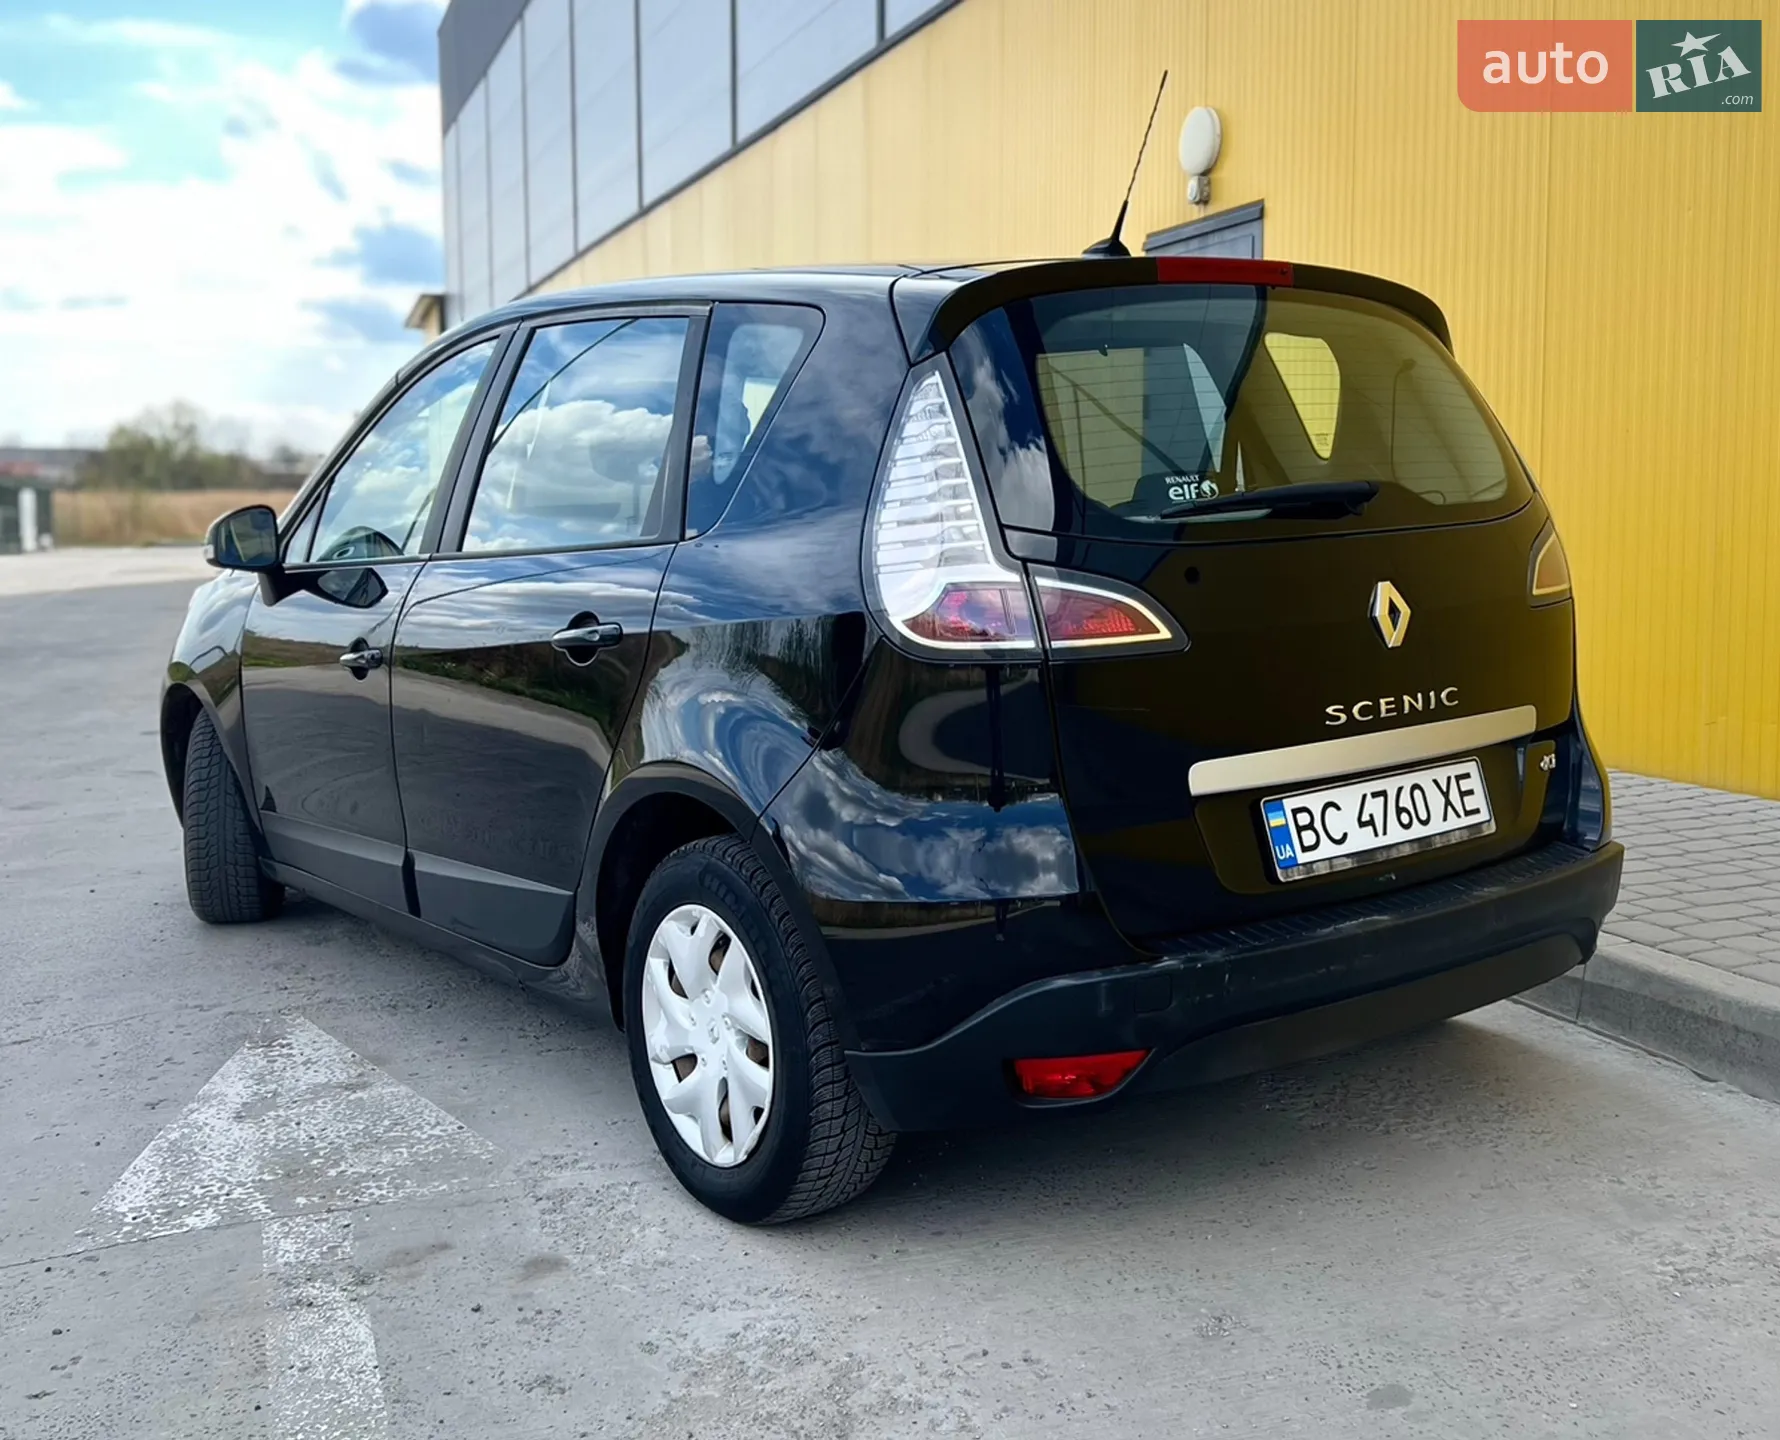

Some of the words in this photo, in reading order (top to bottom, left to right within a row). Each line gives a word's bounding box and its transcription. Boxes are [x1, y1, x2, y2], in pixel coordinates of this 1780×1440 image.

[1164, 474, 1200, 484] RENAULT
[1168, 484, 1200, 501] elf
[1324, 687, 1460, 726] SCENIC
[1290, 801, 1348, 853] BC
[1356, 782, 1431, 838] 4760
[1431, 772, 1482, 822] XE
[1276, 845, 1295, 860] UA
